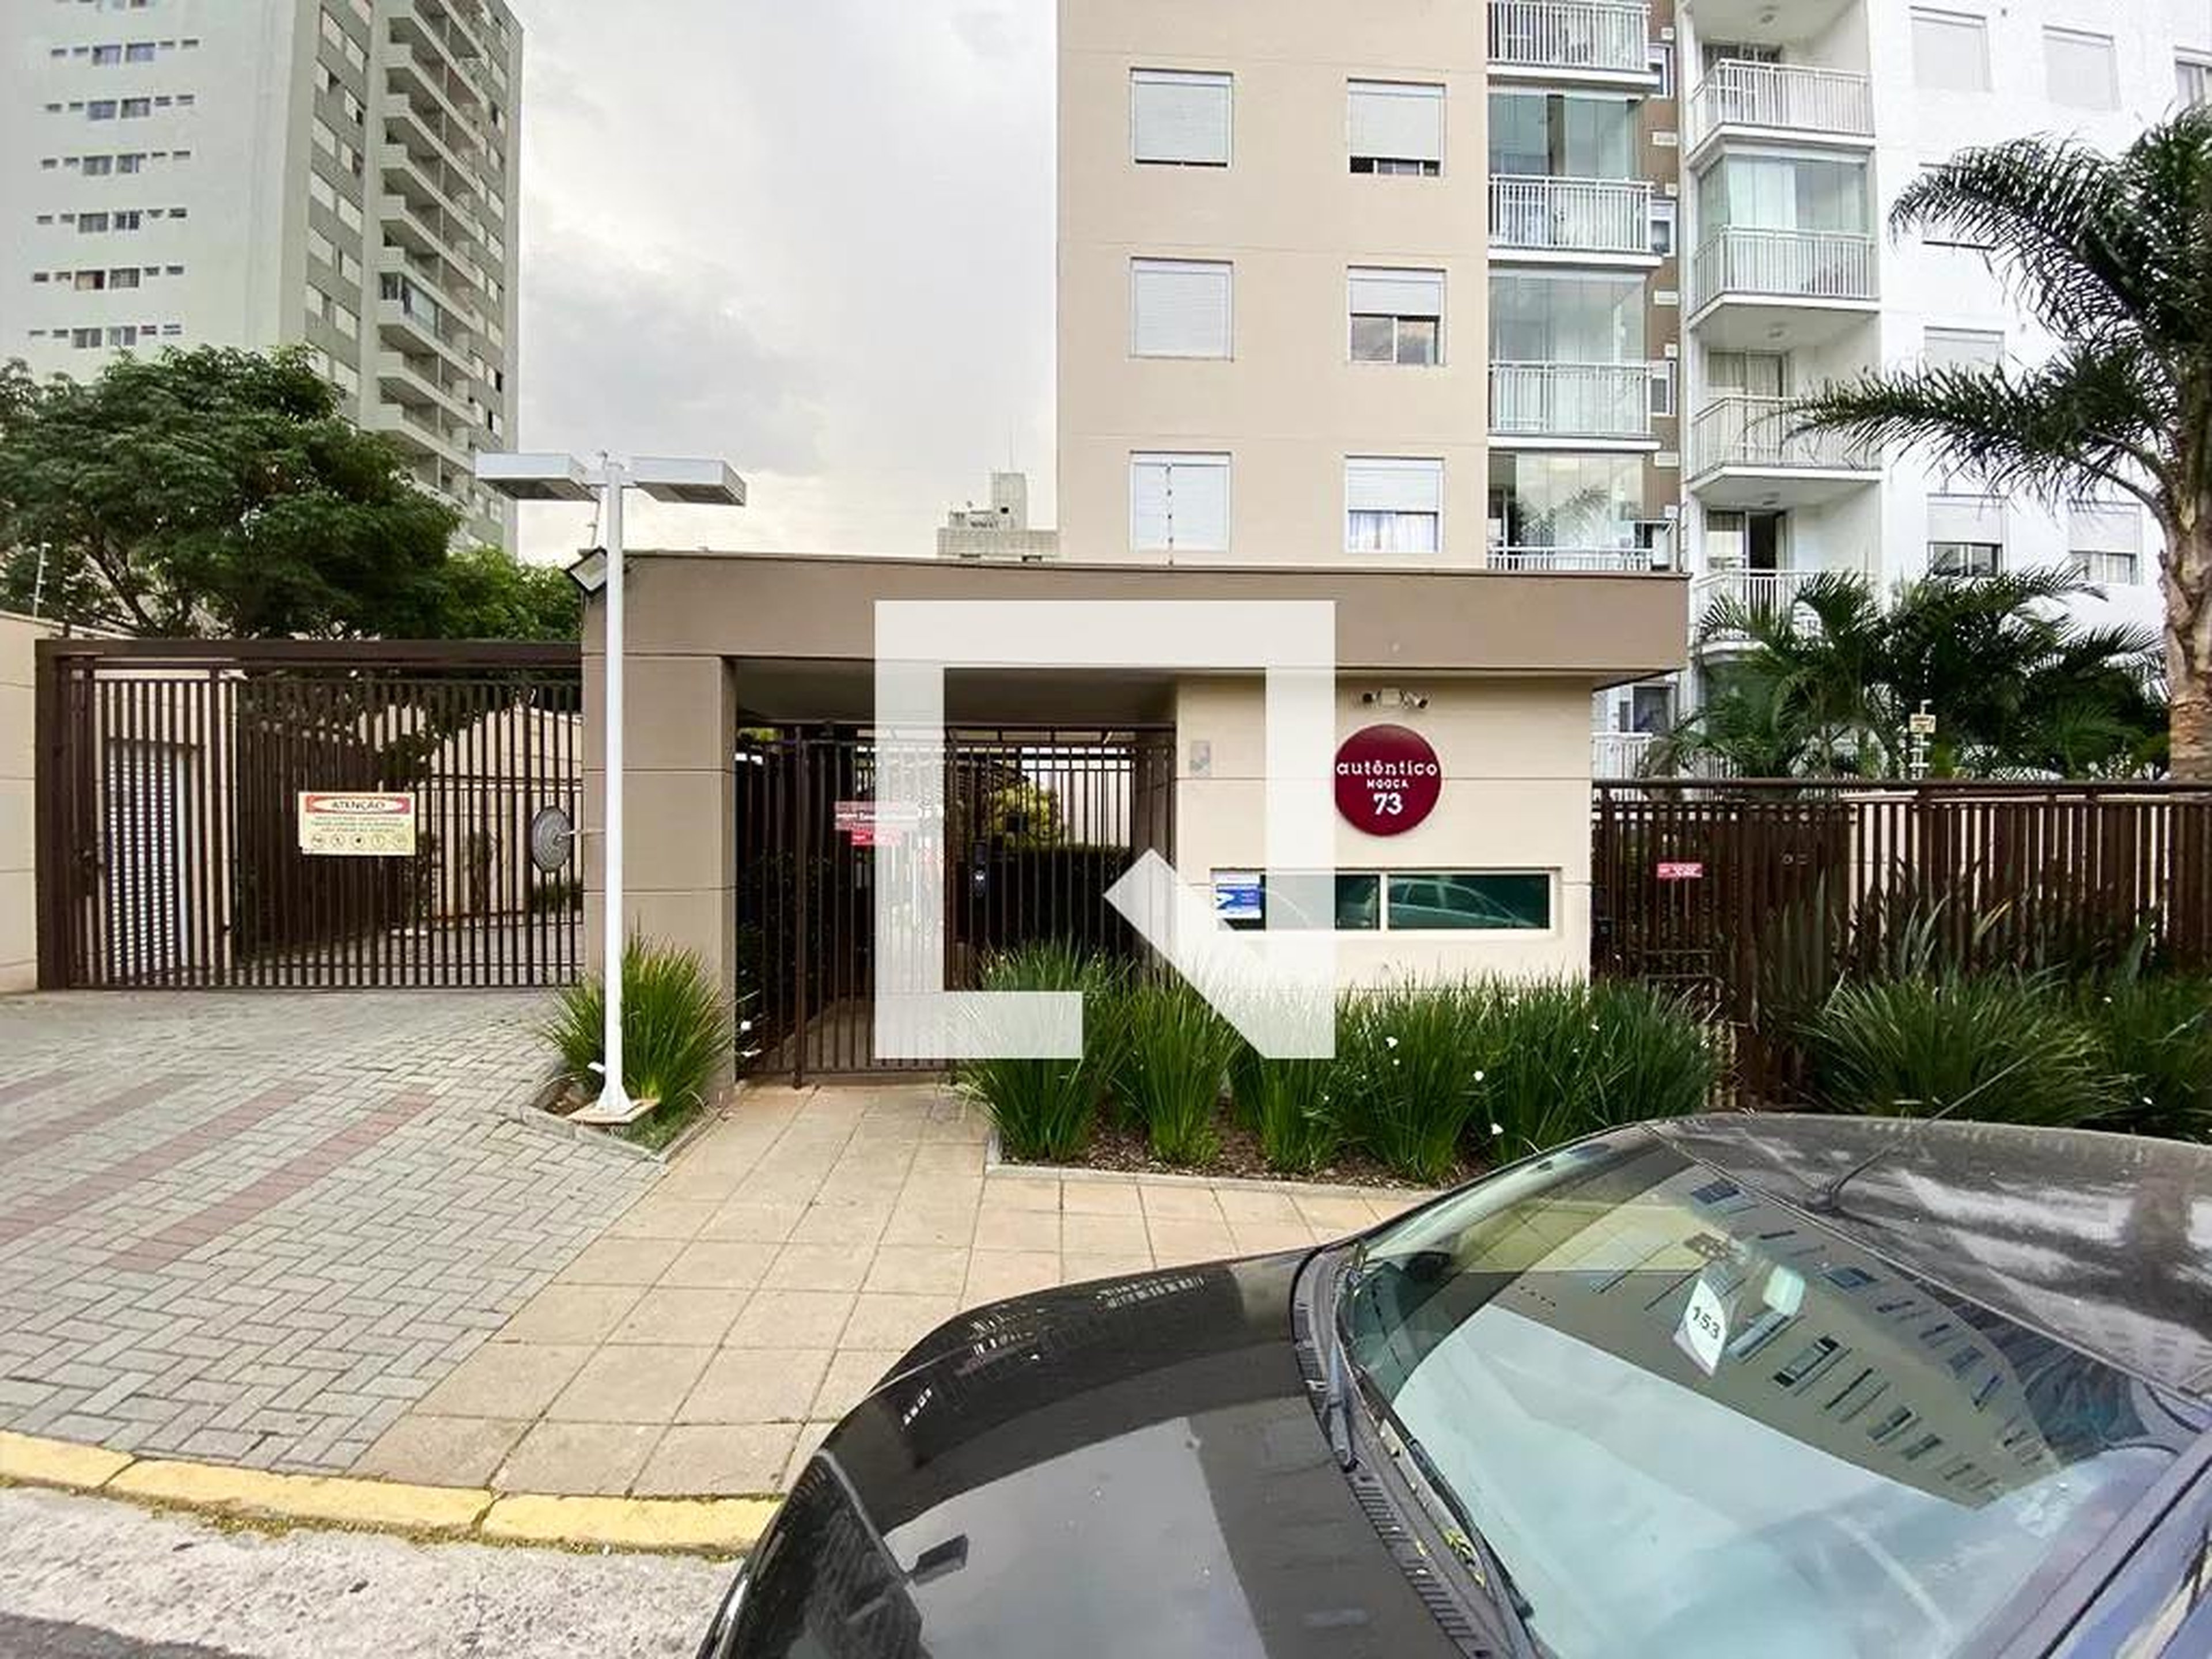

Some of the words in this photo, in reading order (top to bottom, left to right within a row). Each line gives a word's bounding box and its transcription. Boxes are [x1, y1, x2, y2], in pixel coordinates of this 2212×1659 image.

[1366, 779, 1409, 789] MOOCA
[332, 800, 385, 810] ATENÇÃO
[1373, 793, 1403, 815] 73
[1692, 1306, 1721, 1339] 153
